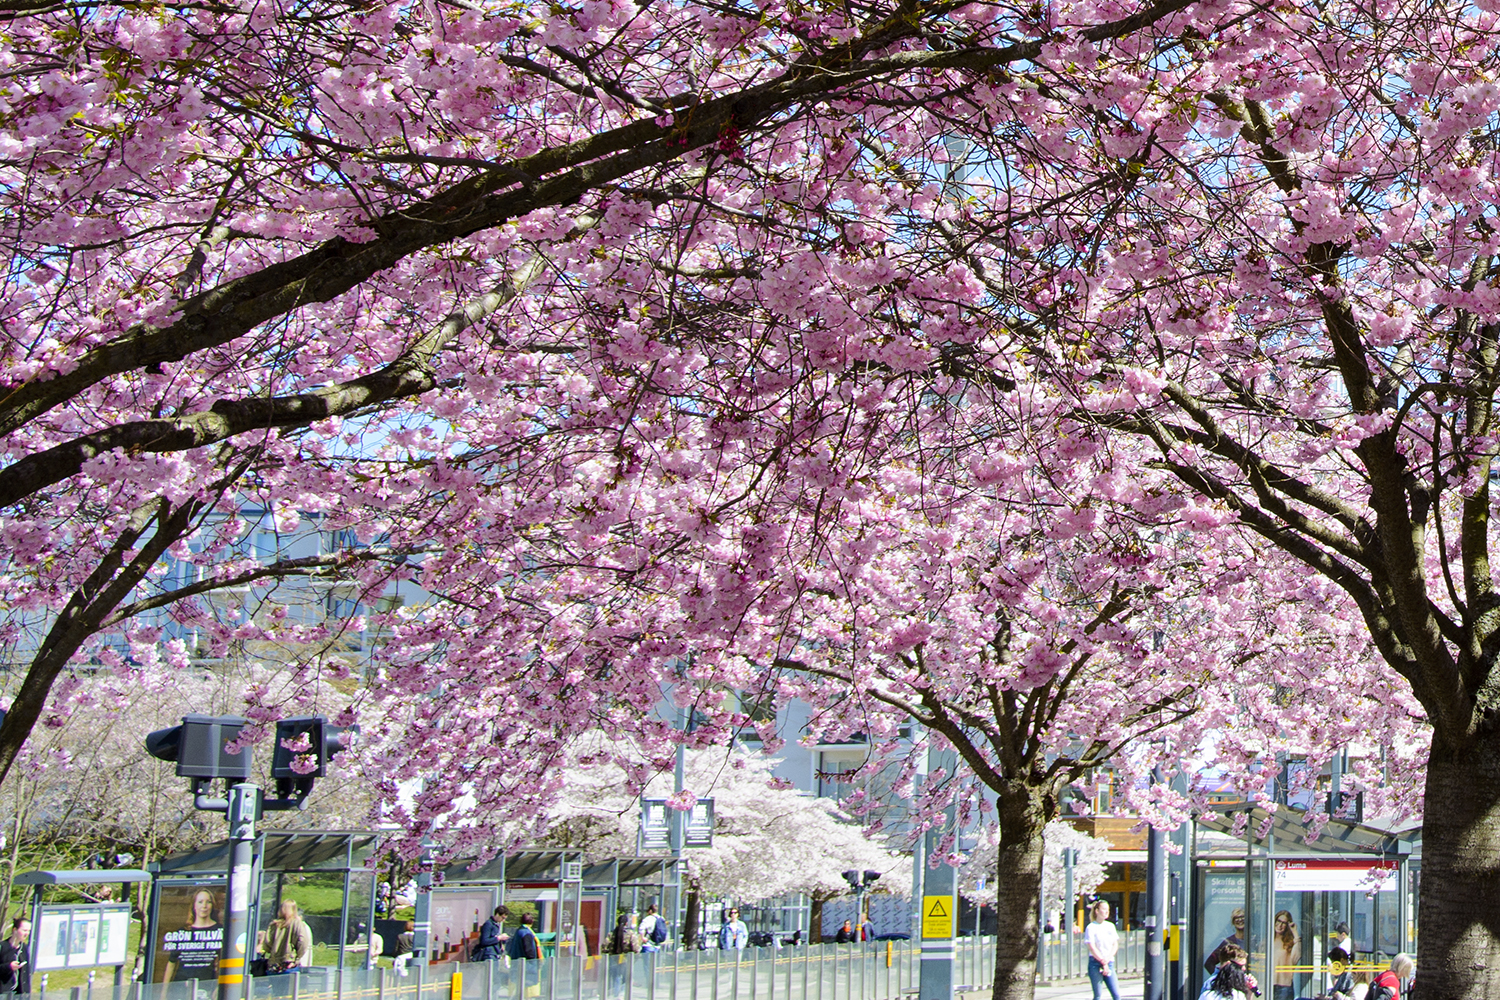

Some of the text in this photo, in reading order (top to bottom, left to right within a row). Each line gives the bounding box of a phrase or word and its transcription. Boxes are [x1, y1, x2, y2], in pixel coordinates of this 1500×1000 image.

[1287, 861, 1307, 869] Luma
[1276, 871, 1286, 879] 74
[1212, 878, 1235, 886] Skaffa
[164, 928, 224, 942] GRÖN TILLVÄ
[164, 942, 176, 950] FÖR
[178, 942, 205, 950] SVERIGE
